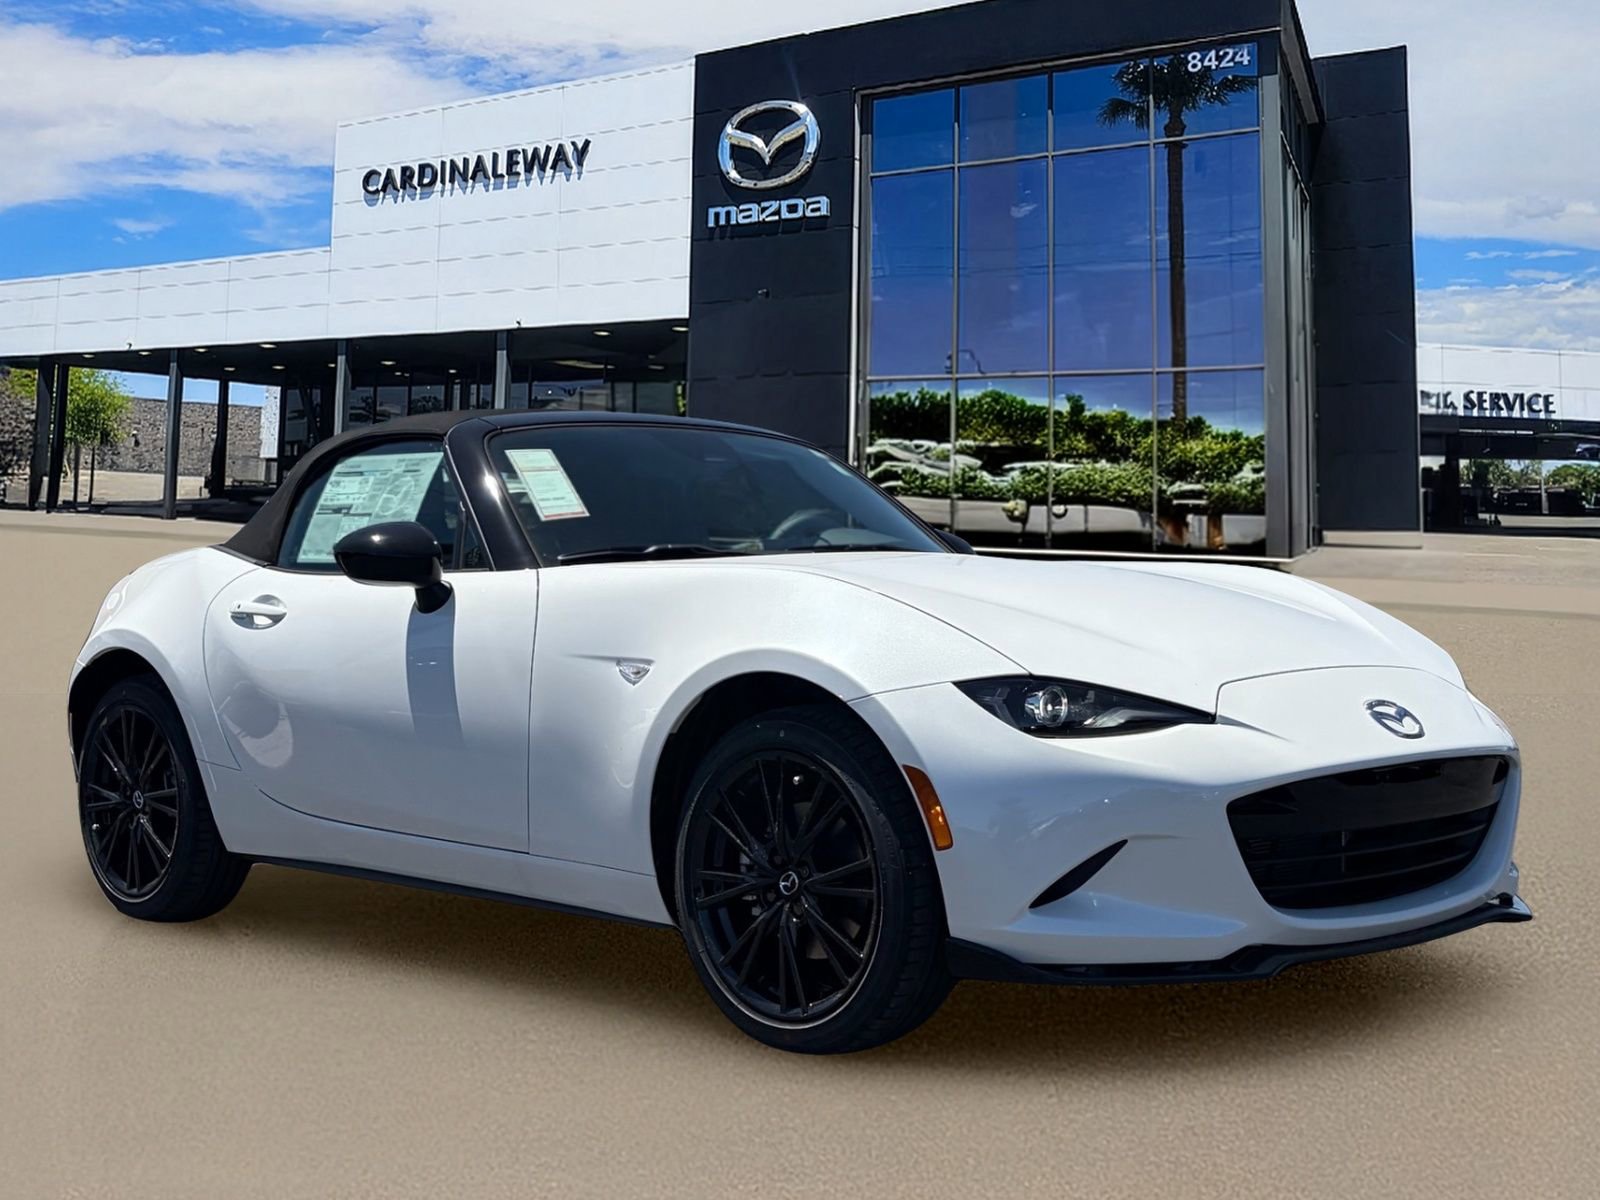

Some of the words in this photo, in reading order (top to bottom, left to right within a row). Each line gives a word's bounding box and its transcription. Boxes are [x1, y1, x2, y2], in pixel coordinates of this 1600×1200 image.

[1187, 46, 1251, 72] 8424
[362, 138, 591, 195] CARDINALEWAY
[707, 195, 831, 228] mazda
[1462, 389, 1557, 415] SERVICE
